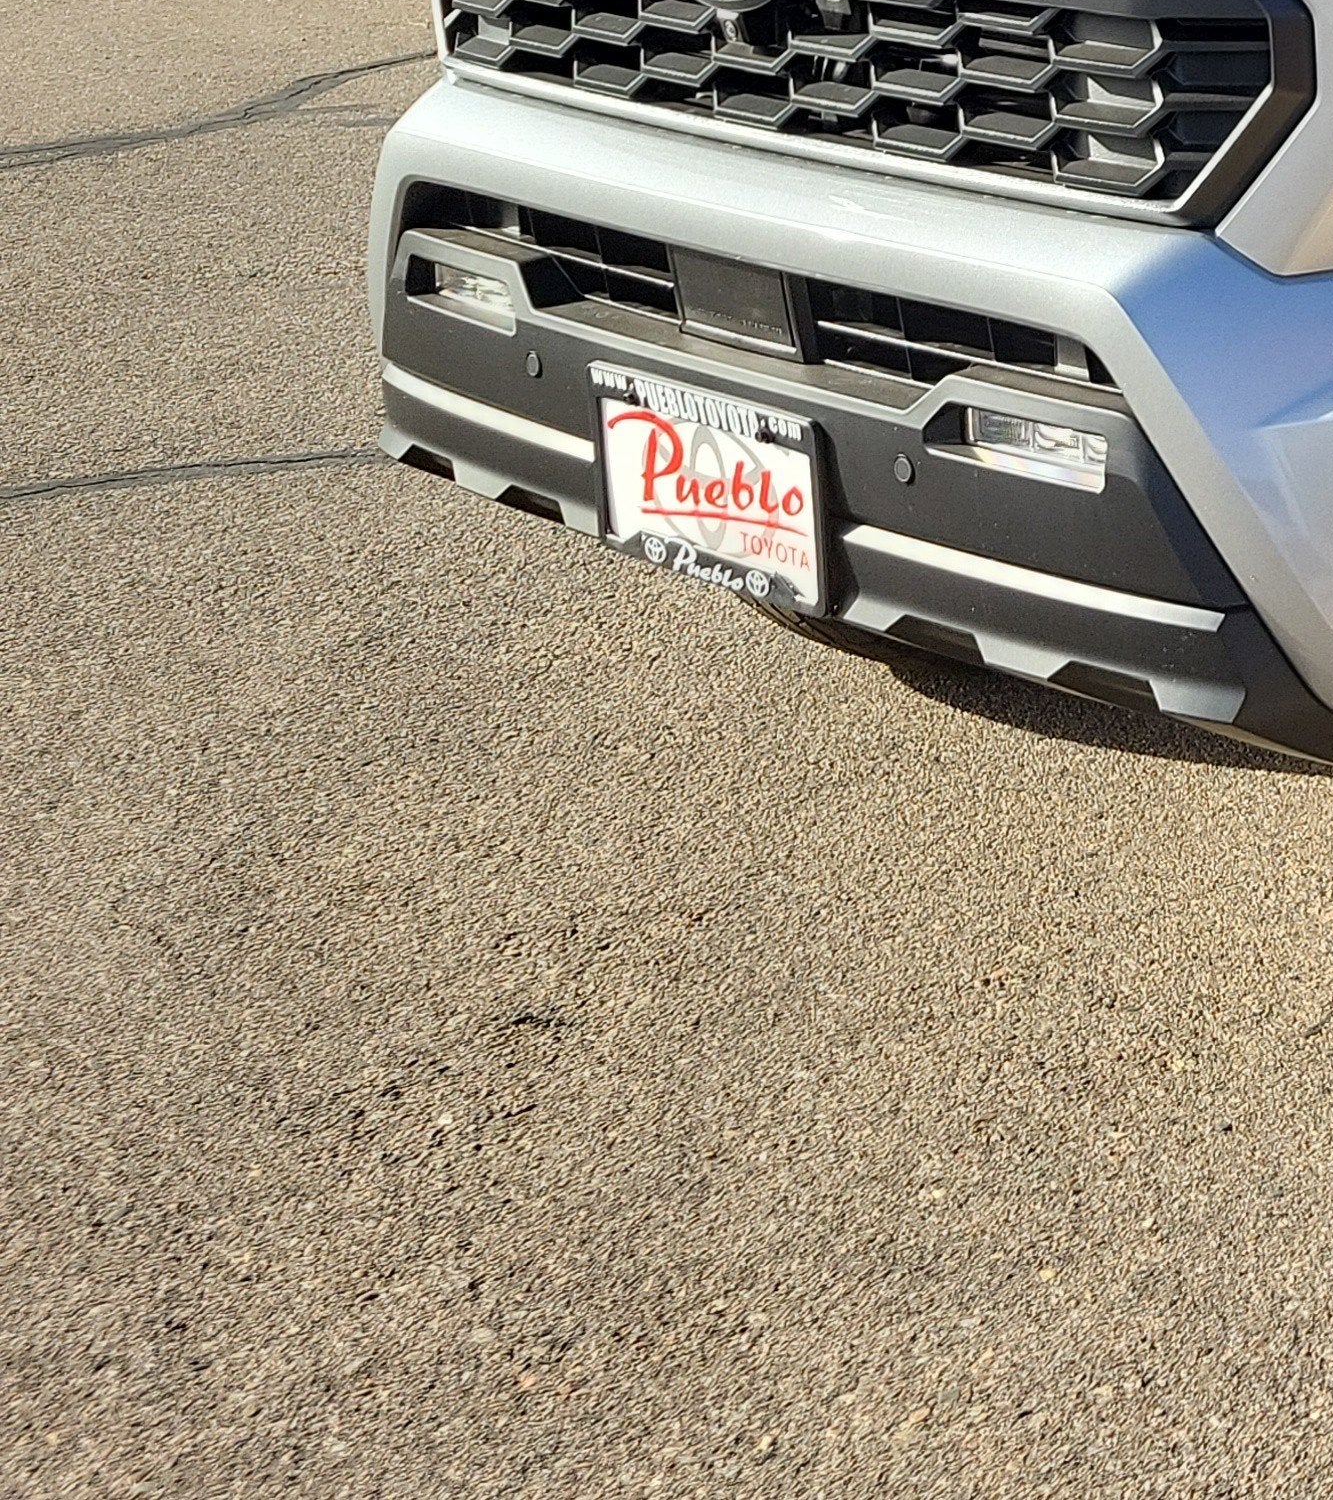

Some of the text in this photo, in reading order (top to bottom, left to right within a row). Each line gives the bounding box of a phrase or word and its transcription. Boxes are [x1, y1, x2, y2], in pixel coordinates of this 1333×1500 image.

[607, 411, 804, 516] Pueblo
[664, 536, 743, 590] Pueblo
[739, 531, 810, 572] TOYOTA
